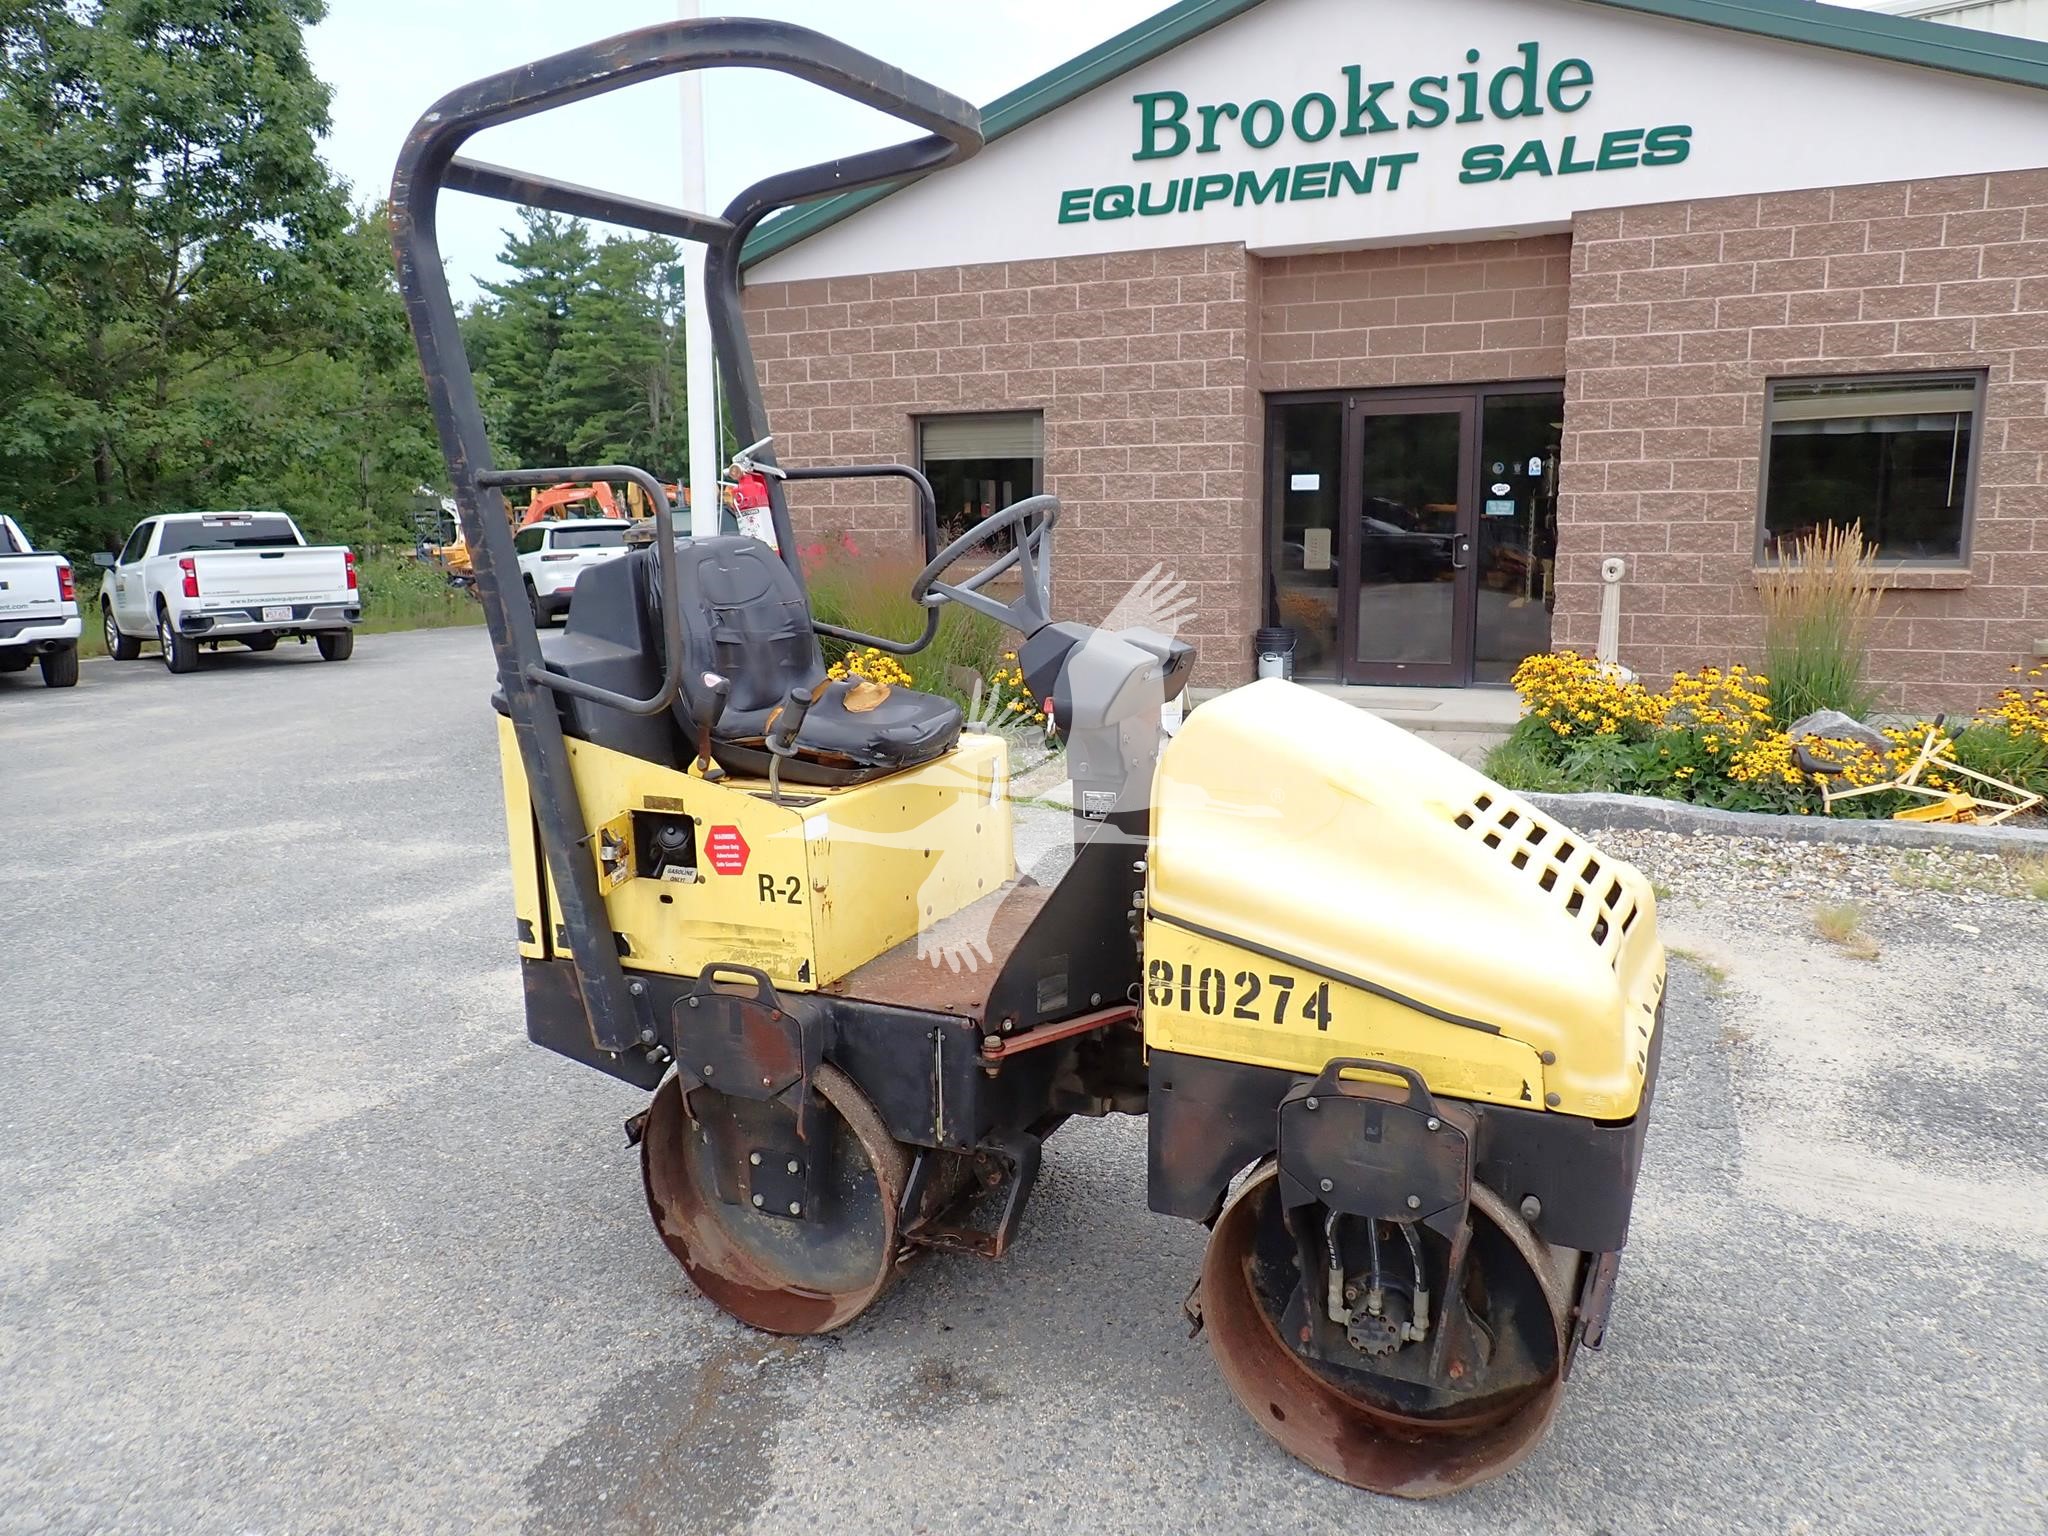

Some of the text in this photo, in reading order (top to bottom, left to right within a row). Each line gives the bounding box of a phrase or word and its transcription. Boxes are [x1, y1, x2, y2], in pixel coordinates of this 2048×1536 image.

[1133, 42, 1594, 161] Brookside
[1058, 125, 1691, 224] EQUIPMENT SALES
[667, 868, 694, 877] GASOLINE
[758, 873, 803, 905] R-2
[1148, 959, 1333, 1032] 810274
